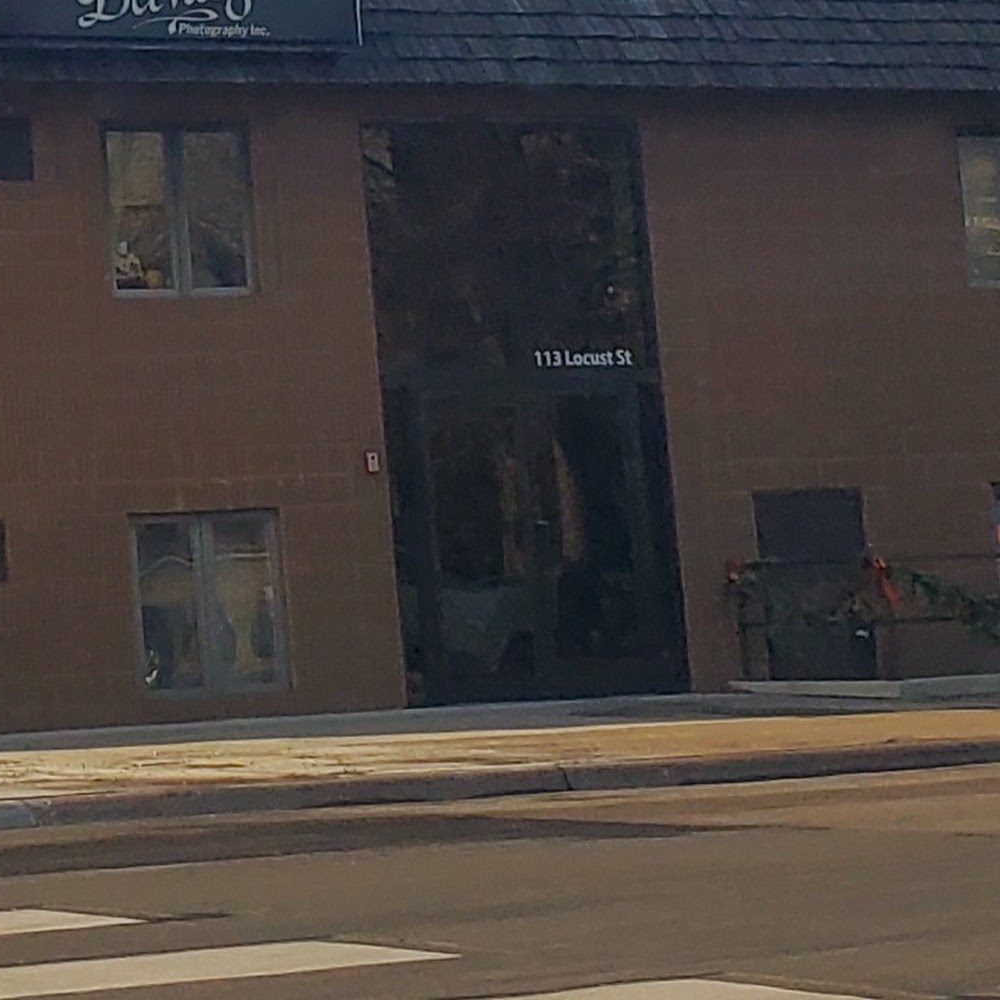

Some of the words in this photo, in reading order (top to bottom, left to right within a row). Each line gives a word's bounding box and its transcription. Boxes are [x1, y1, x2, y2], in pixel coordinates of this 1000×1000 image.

[178, 22, 248, 38] Photography
[534, 350, 561, 367] 113
[564, 350, 614, 366] Locust
[615, 349, 633, 365] St
